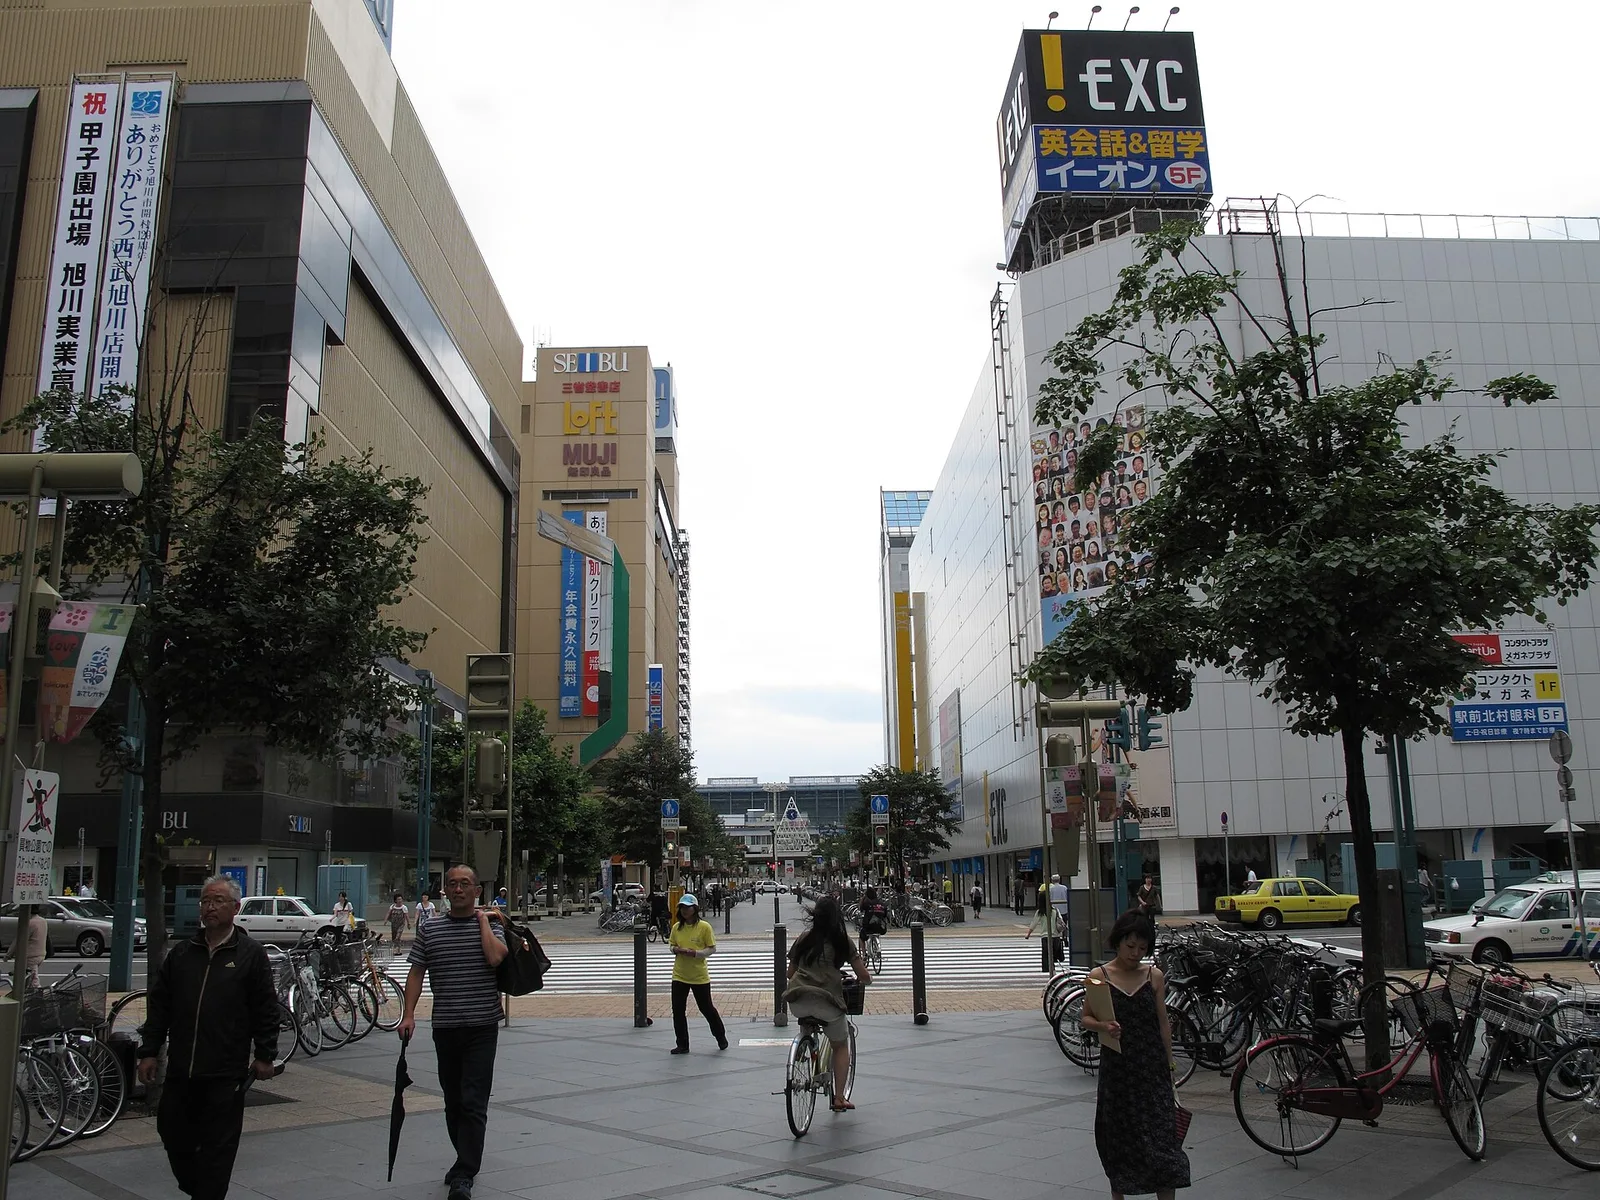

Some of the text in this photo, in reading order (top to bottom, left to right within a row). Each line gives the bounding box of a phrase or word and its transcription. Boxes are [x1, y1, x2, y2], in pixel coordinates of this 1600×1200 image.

[1079, 58, 1188, 112] EXC
[82, 92, 107, 116] 祝
[1038, 128, 1206, 159] 英会話&留学
[65, 122, 104, 247] 甲子園出場
[1045, 159, 1202, 189] イーオン 5F
[553, 352, 629, 373] SEIBU
[562, 443, 617, 466] MUJI
[567, 466, 612, 477] 無印良品
[564, 589, 578, 687] 年会費永久無料
[1505, 650, 1551, 662] メガネプラザ
[1477, 673, 1532, 686] コンタクト
[1539, 680, 1557, 692] 1F
[650, 681, 662, 721] SEIBU
[1454, 708, 1561, 724] 駅前北村眼科 5F
